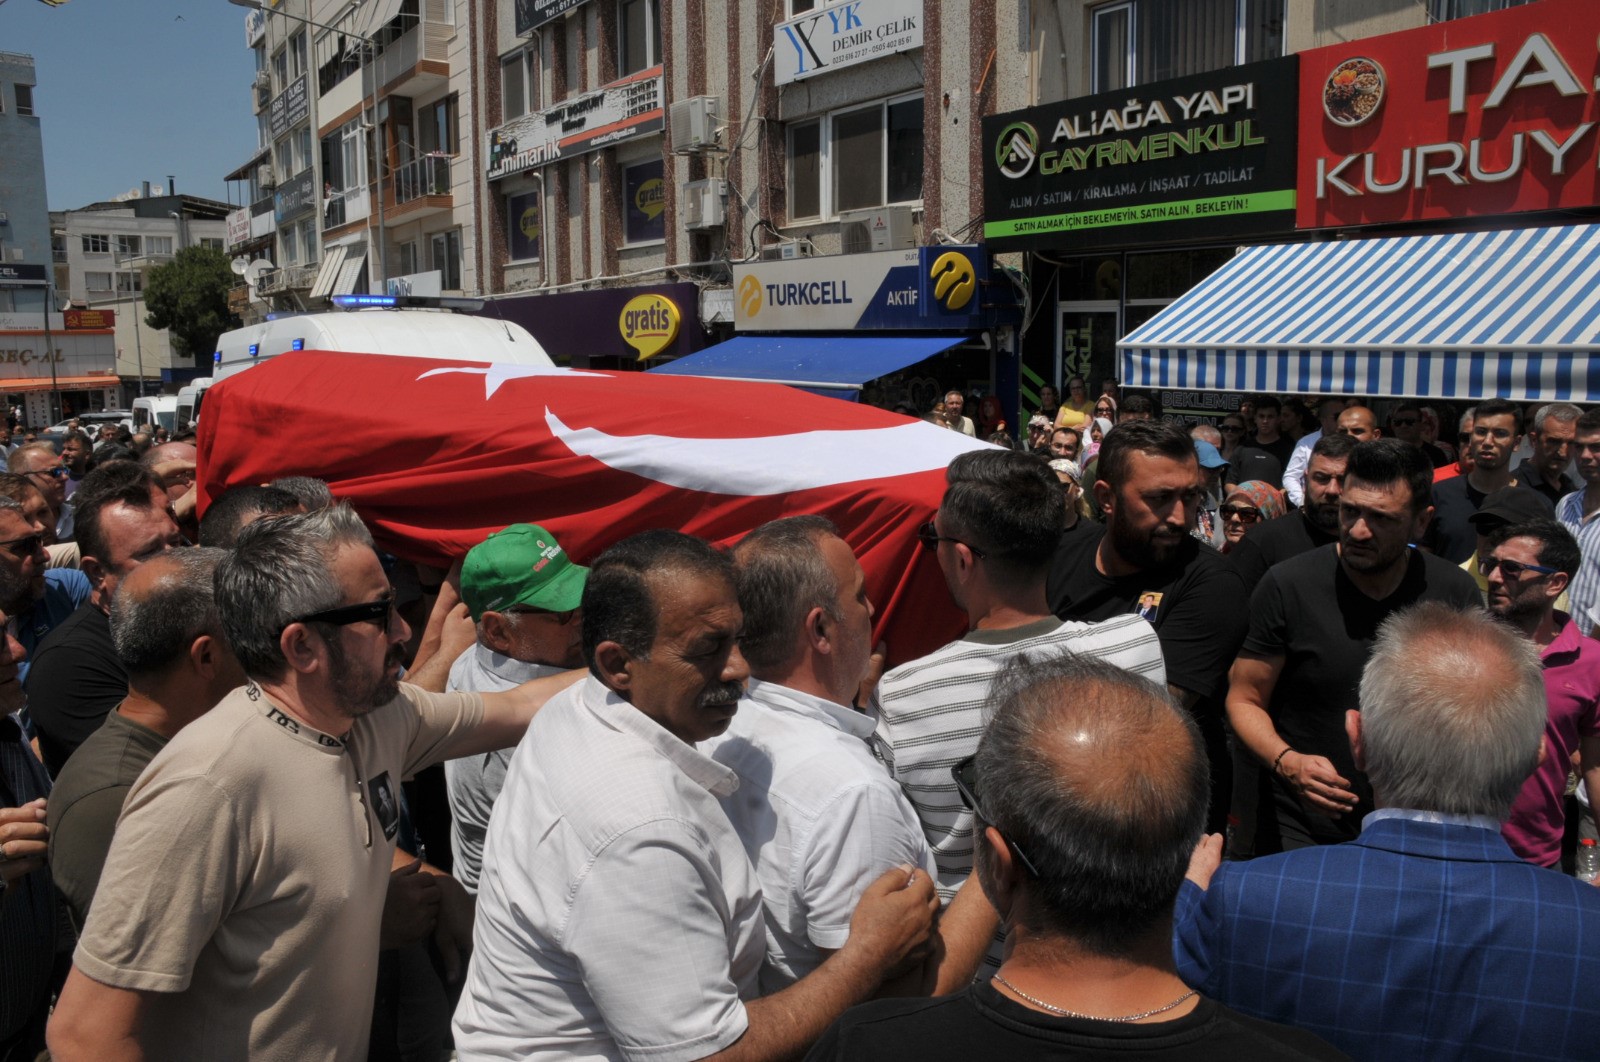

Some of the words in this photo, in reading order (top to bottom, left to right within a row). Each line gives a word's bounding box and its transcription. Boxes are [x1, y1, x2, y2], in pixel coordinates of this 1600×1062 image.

[828, 2, 863, 34] YK
[833, 29, 873, 52] DEMİR
[876, 16, 917, 42] ÇELİK
[886, 40, 897, 50] 402
[906, 36, 913, 45] 61
[1427, 31, 1600, 114] TA
[1051, 98, 1172, 143] ALİAĞA
[1172, 82, 1255, 120] YAPI
[501, 137, 562, 174] mimarlık
[1039, 119, 1266, 175] GAYRİMENKUL
[1316, 122, 1600, 199] KURUY
[639, 182, 665, 206] grati
[1009, 193, 1032, 210] ALIM
[1043, 190, 1072, 206] SATIM
[1083, 182, 1137, 201] KİRALAMA
[1149, 174, 1190, 194] İNŞAAT
[1204, 167, 1255, 186] TADİLAT
[522, 214, 539, 233] grati
[1014, 220, 1036, 233] SATIN
[1037, 216, 1064, 231] ALMAK
[1065, 213, 1081, 230] İÇİN
[1083, 207, 1140, 227] BEKLEMEYİN.
[1140, 206, 1166, 221] SATIN
[1168, 204, 1190, 217] ALIN
[1196, 198, 1243, 215] BEKLEYİN
[766, 280, 853, 306] TURKCELL
[886, 285, 918, 306] AKTİF
[625, 300, 670, 339] gratis
